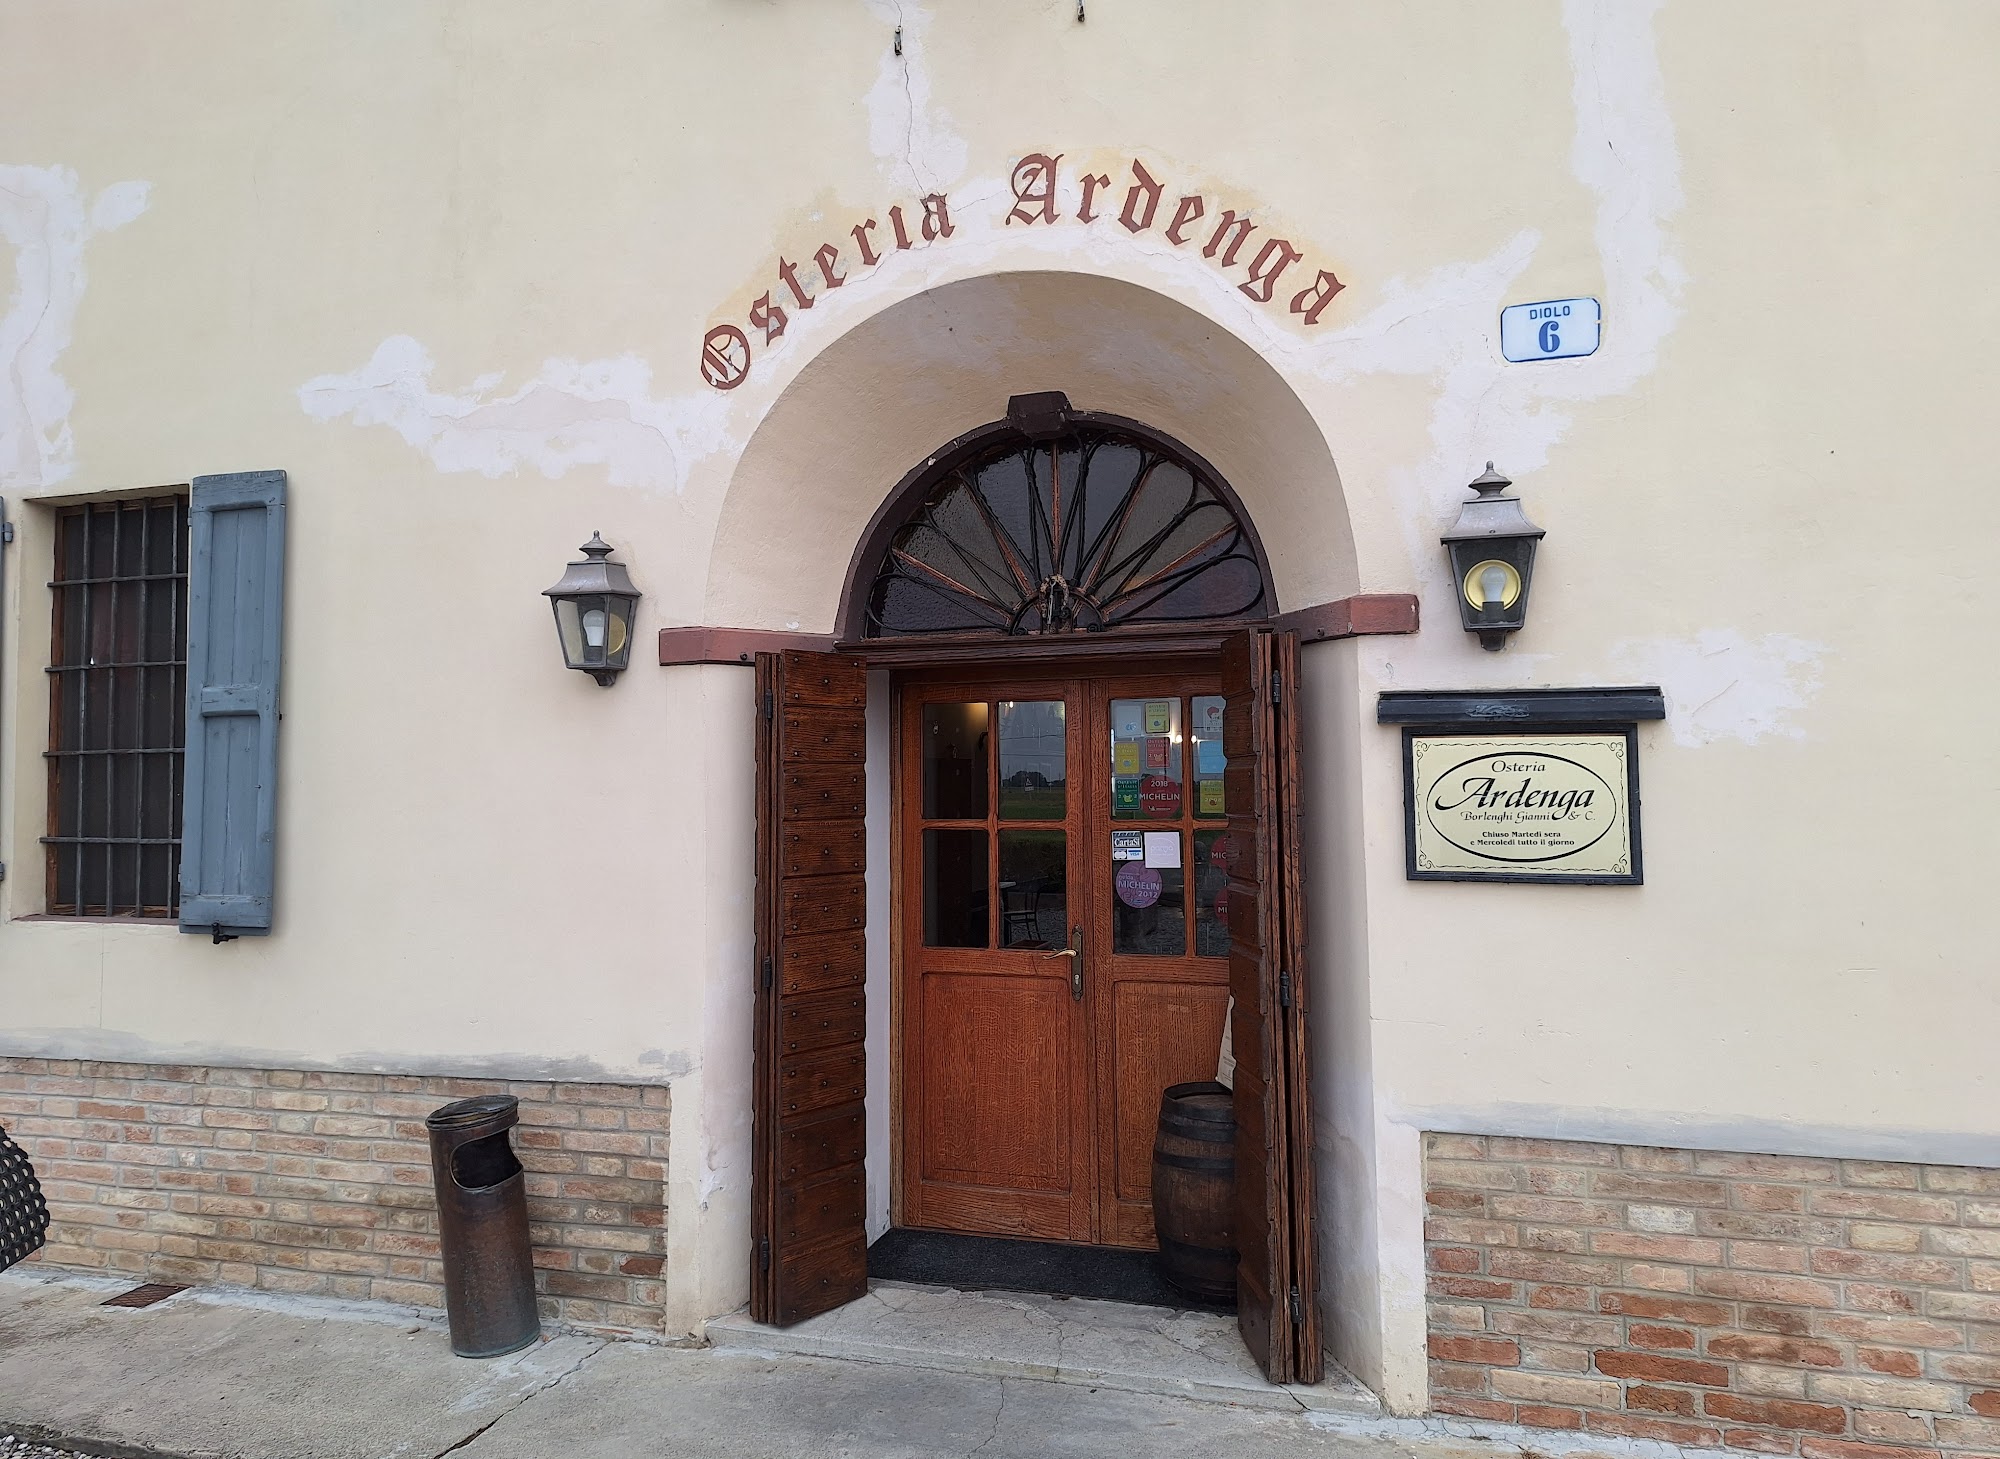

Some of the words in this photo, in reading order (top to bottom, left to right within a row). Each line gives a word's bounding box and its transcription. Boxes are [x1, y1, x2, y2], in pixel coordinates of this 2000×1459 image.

[701, 192, 955, 390] Osteria
[1005, 152, 1346, 326] Ardenga
[1530, 305, 1571, 320] DIOLO
[1538, 320, 1560, 353] 6
[1491, 760, 1546, 773] Osteria
[1139, 793, 1180, 801] MICHELIN
[1435, 777, 1595, 821] Ardenga
[1460, 810, 1513, 823] Borlenghi
[1514, 810, 1550, 824] Gianni
[1567, 811, 1581, 821] &
[1585, 810, 1596, 821] C.
[1547, 839, 1575, 847] giorno
[1118, 880, 1160, 891] MICHELIN
[1138, 890, 1158, 898] 2012
